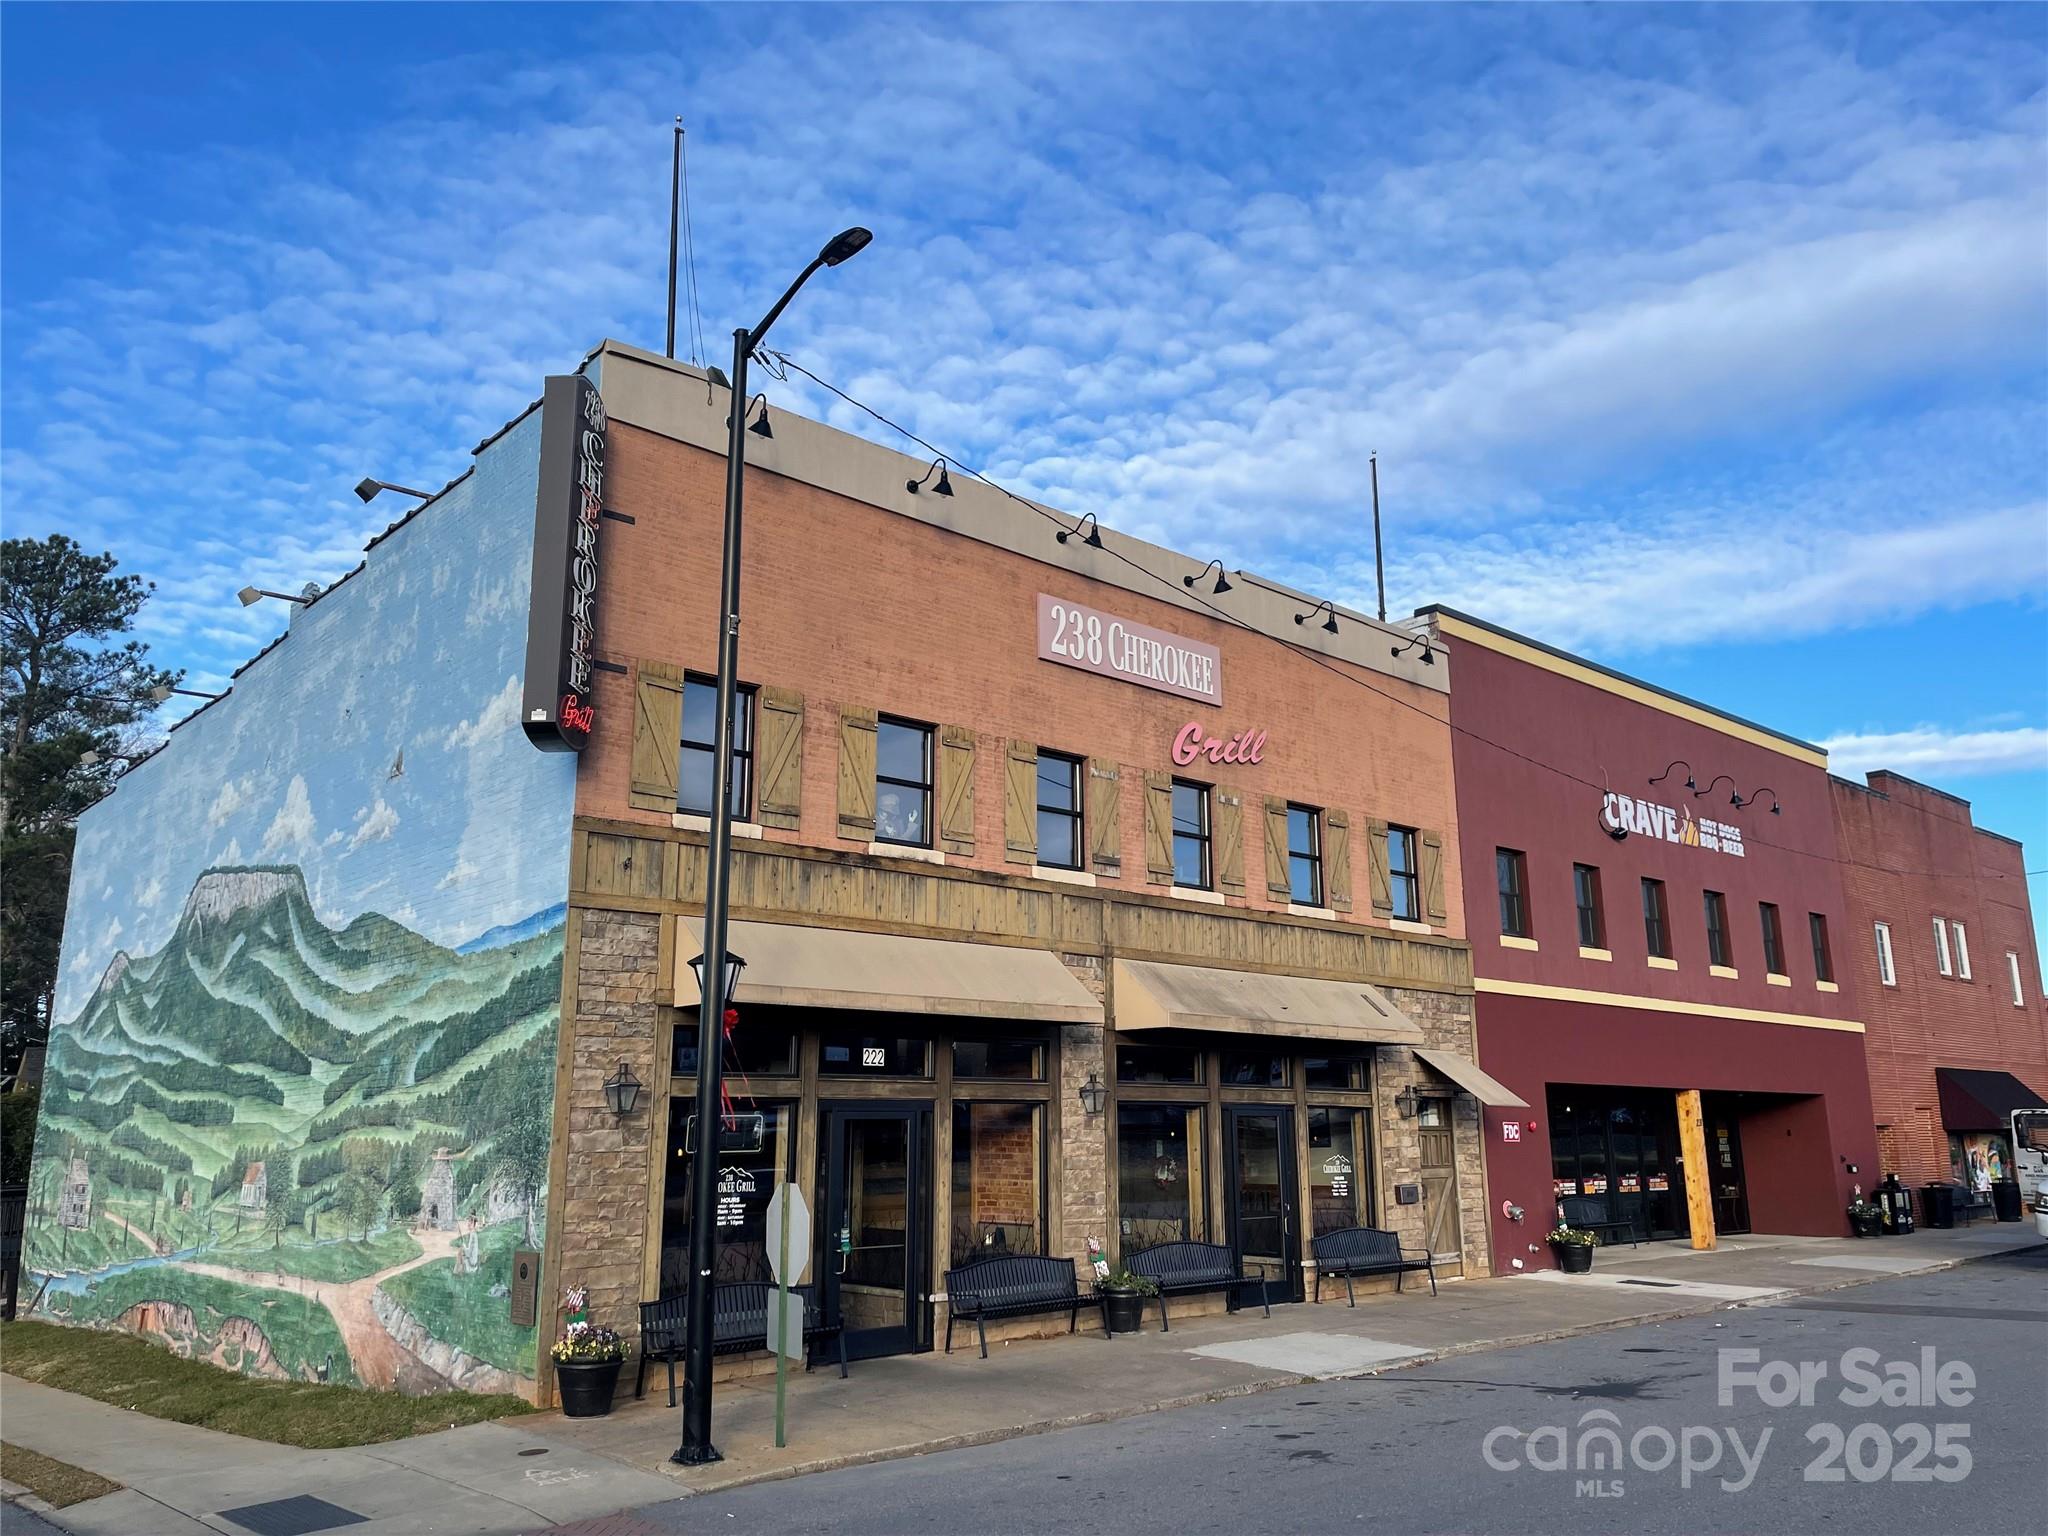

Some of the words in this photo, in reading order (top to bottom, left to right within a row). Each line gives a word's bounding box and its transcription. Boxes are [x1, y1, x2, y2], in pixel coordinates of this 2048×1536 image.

[568, 430, 604, 695] CHEROKEE
[1050, 604, 1103, 665] 238
[1108, 622, 1214, 695] CHEROKEE
[560, 694, 594, 733] Grill
[1172, 720, 1269, 767] Grill
[1603, 793, 1680, 844] CRAVE
[1699, 817, 1717, 835] HOT
[1718, 822, 1741, 841] DOGS
[1699, 832, 1719, 853] BBQ
[1722, 838, 1745, 858] BEER
[864, 1049, 884, 1065] 222
[1503, 1124, 1520, 1140] FDC
[717, 1181, 735, 1193] OKEE
[736, 1180, 756, 1192] GRILL
